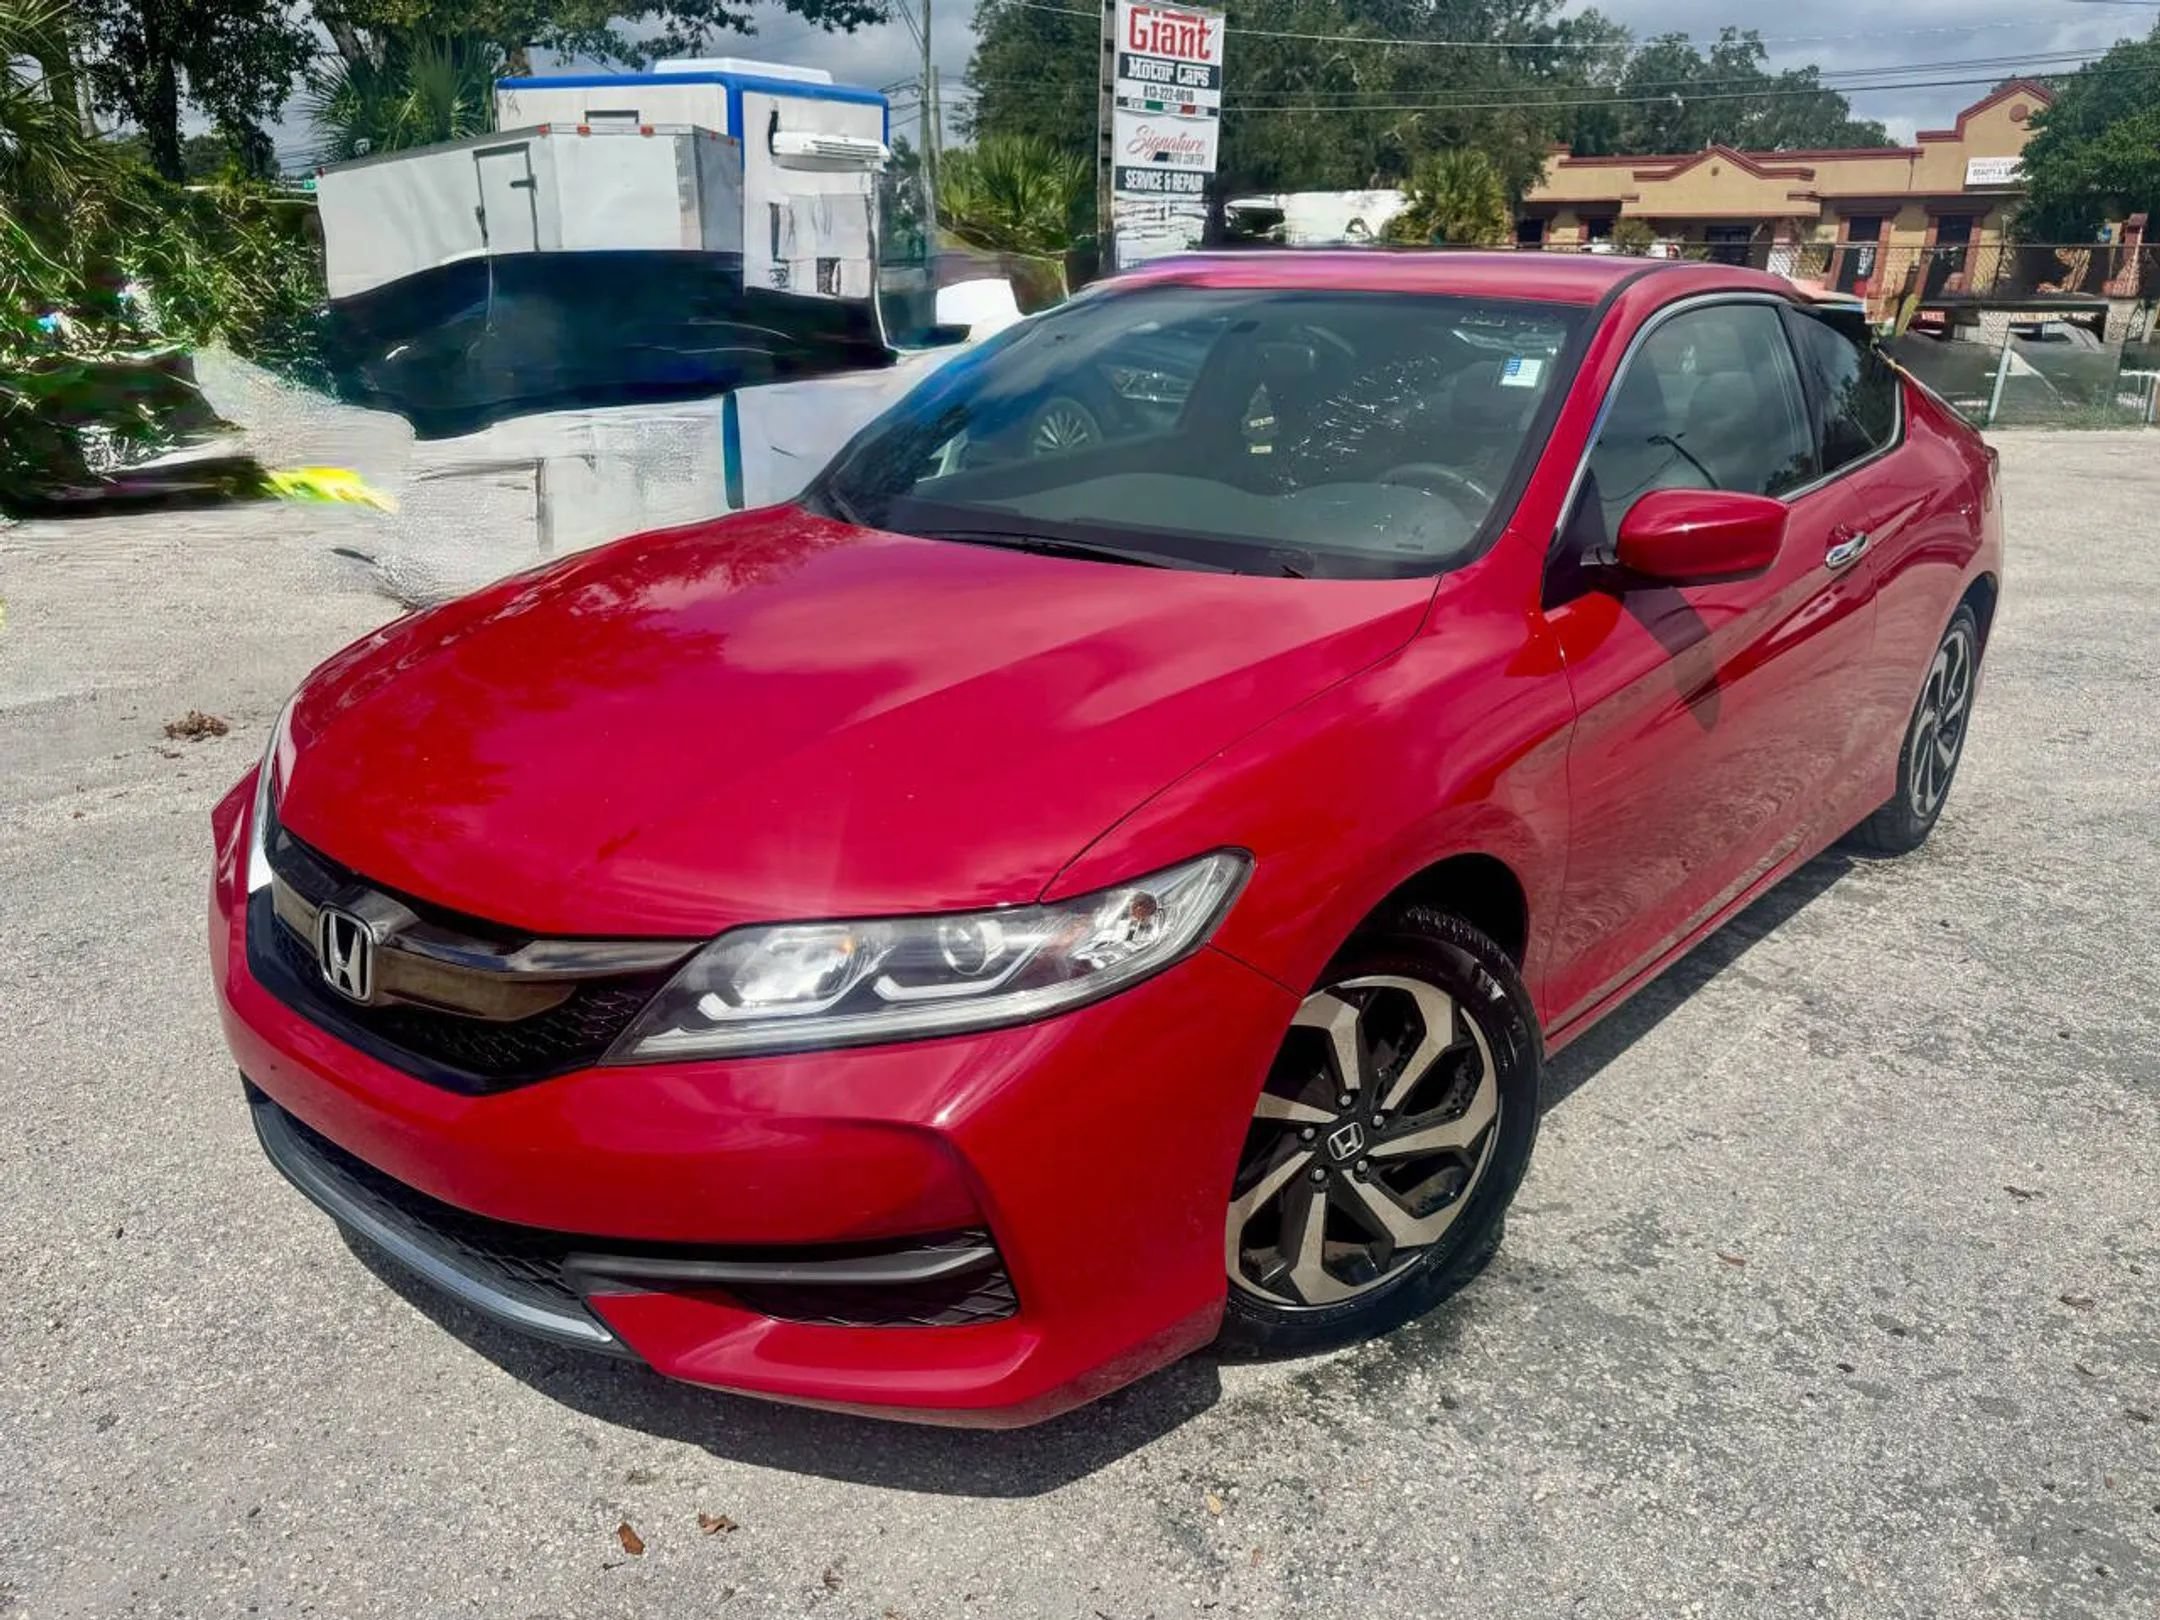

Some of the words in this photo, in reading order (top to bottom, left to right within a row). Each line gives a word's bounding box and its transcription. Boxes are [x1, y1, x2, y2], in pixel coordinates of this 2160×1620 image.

[1129, 7, 1212, 60] Giant
[1127, 55, 1175, 82] Motor
[1176, 64, 1211, 87] Cars
[1126, 124, 1205, 161] Signature
[1125, 169, 1163, 190] SERVICE
[1172, 172, 1204, 192] REPAIR
